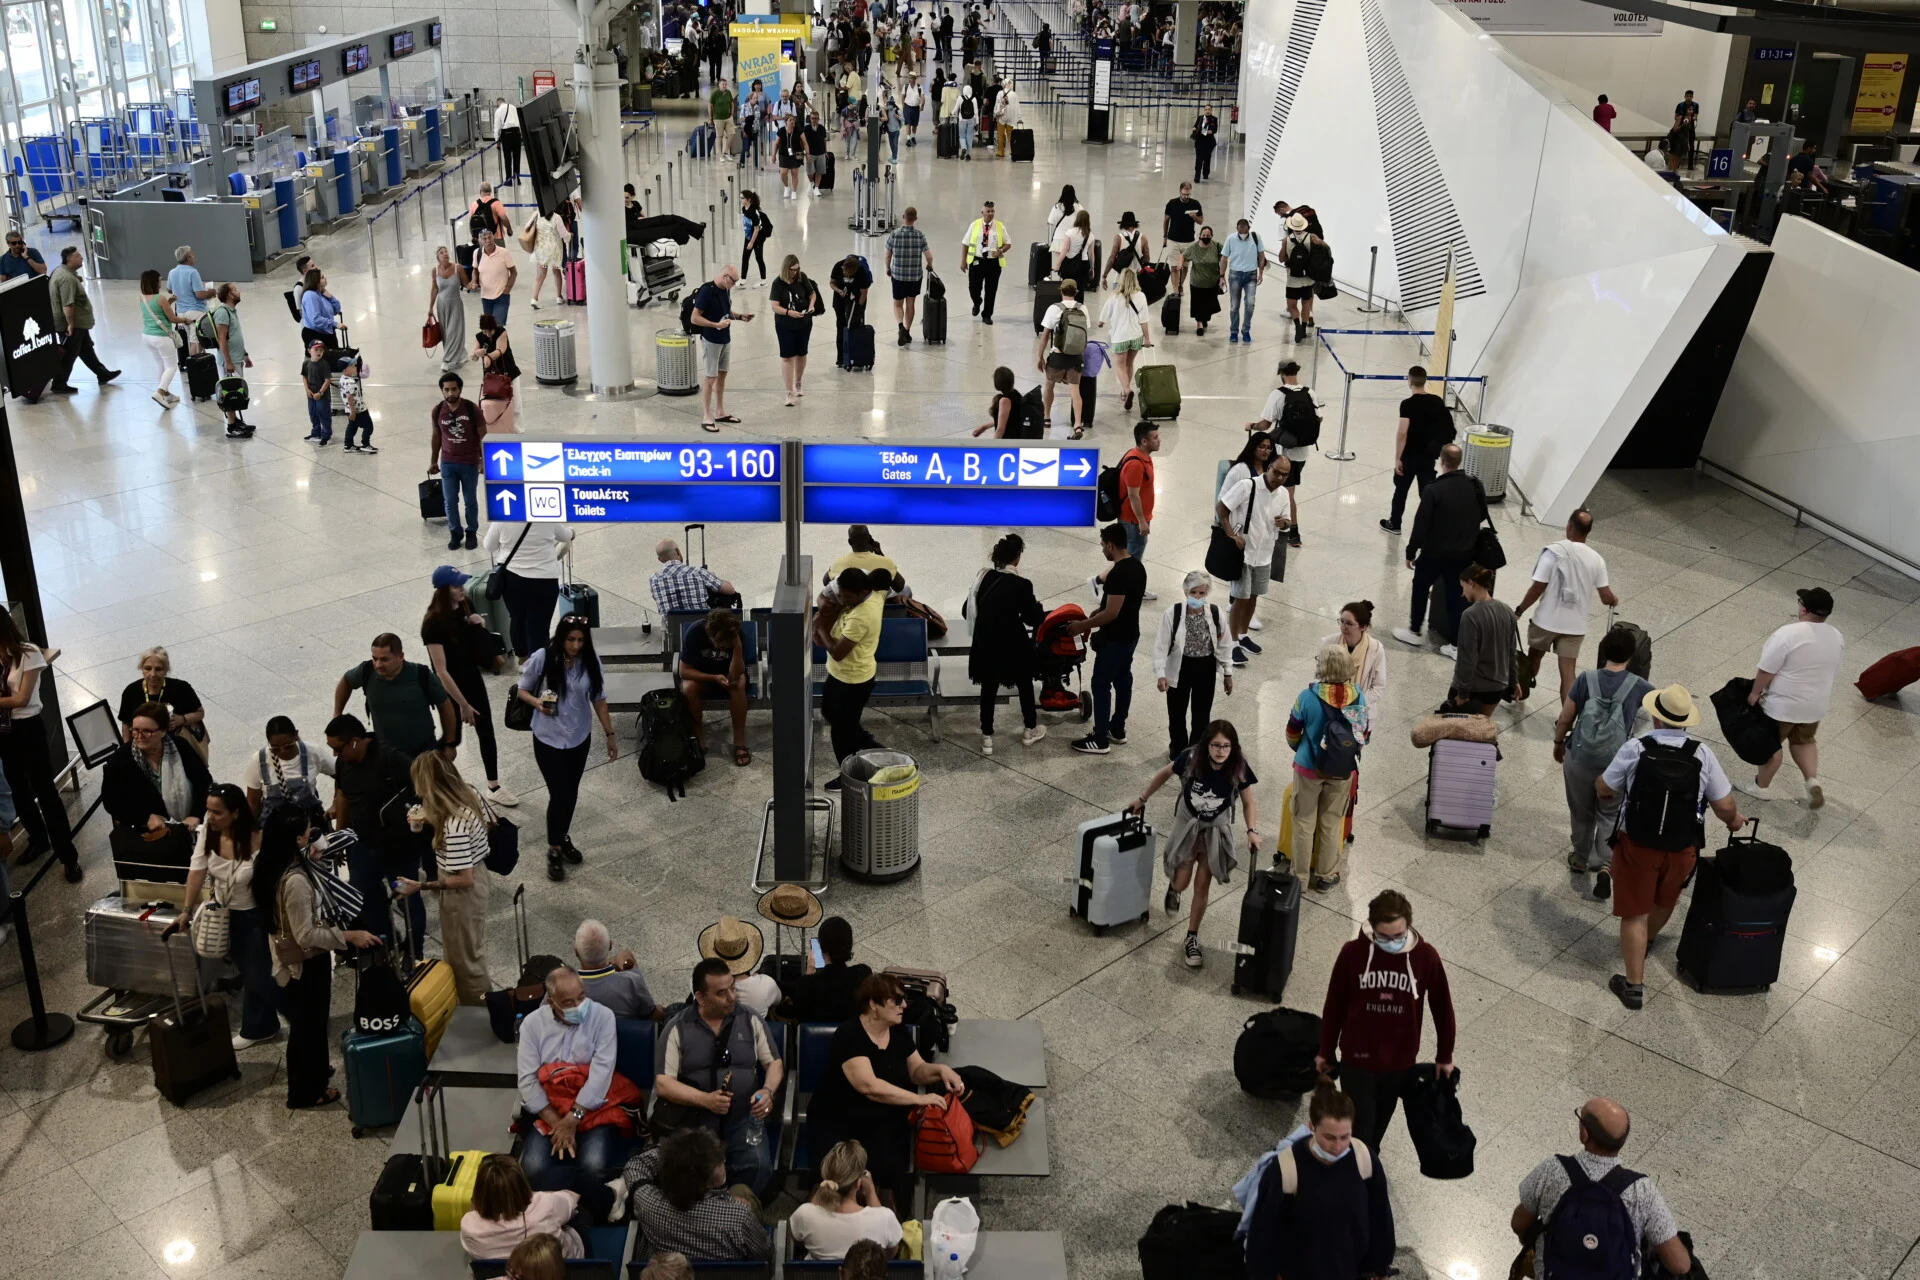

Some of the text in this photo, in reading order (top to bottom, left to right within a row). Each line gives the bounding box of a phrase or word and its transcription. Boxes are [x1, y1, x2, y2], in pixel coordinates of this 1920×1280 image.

[1613, 13, 1648, 21] VOLOTEA
[1768, 50, 1783, 58] 1-31
[740, 53, 775, 71] WRAP
[745, 64, 778, 77] YOUR BAG
[1703, 156, 1728, 171] 16
[13, 333, 53, 359] coffee berry
[564, 448, 612, 463] Έλεγχος
[679, 448, 775, 478] 93-160
[879, 451, 918, 466] Έξοδοι
[568, 464, 611, 477] Check-in
[882, 468, 912, 480] Gates
[925, 452, 1016, 485] A, B, C
[534, 496, 557, 508] WC
[572, 487, 629, 502] Τουαλέτες
[573, 504, 606, 516] Toilets
[360, 1014, 400, 1030] BOSS
